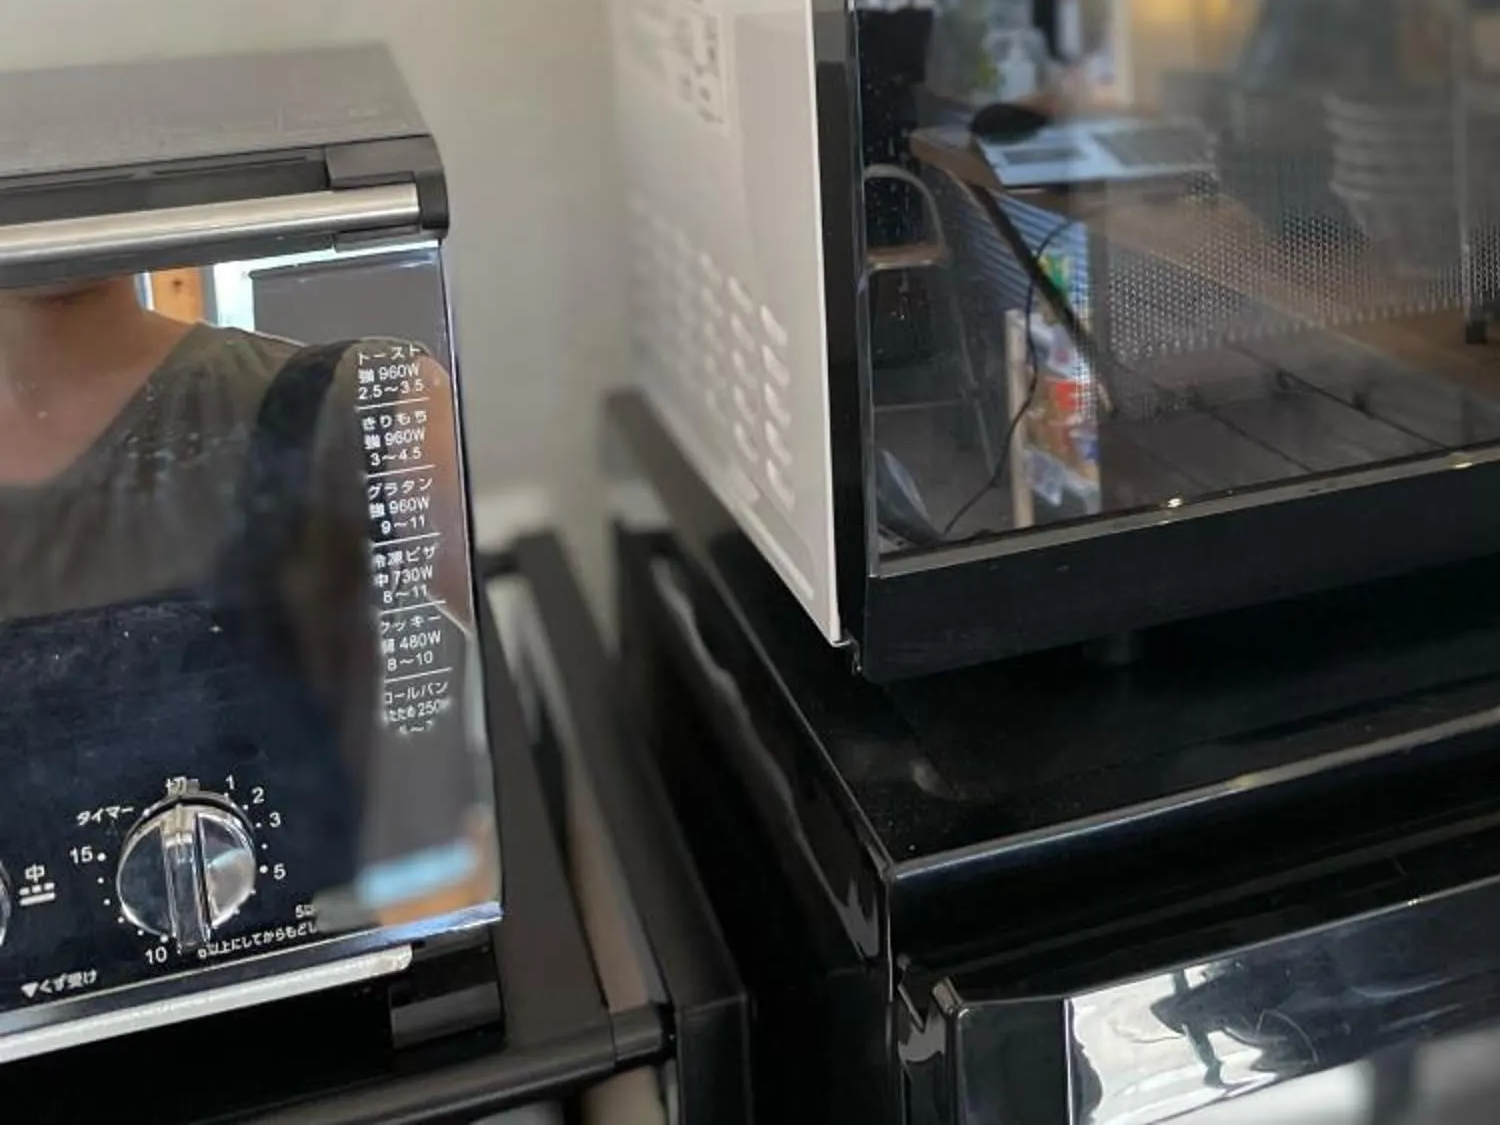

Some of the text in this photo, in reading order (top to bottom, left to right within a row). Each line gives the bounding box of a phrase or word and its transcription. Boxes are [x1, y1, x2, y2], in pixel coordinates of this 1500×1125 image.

[359, 343, 421, 365] トースト
[378, 362, 420, 380] 960W
[362, 410, 427, 431] きりもち
[384, 426, 426, 446] 960W
[368, 478, 433, 500] グラタン
[389, 496, 430, 514] 960W
[373, 542, 439, 568] 冷凍ピザ
[374, 565, 433, 587] 中 730W
[380, 615, 441, 633] クッキー
[400, 630, 441, 649] 480W
[383, 682, 448, 704] ロールパン
[225, 775, 235, 790] 1
[252, 787, 265, 803] 2
[76, 806, 134, 826] タイマー
[269, 811, 281, 828] 3
[70, 846, 93, 864] 15
[24, 864, 45, 882] 中
[273, 863, 286, 880] 5
[145, 947, 167, 964] 10
